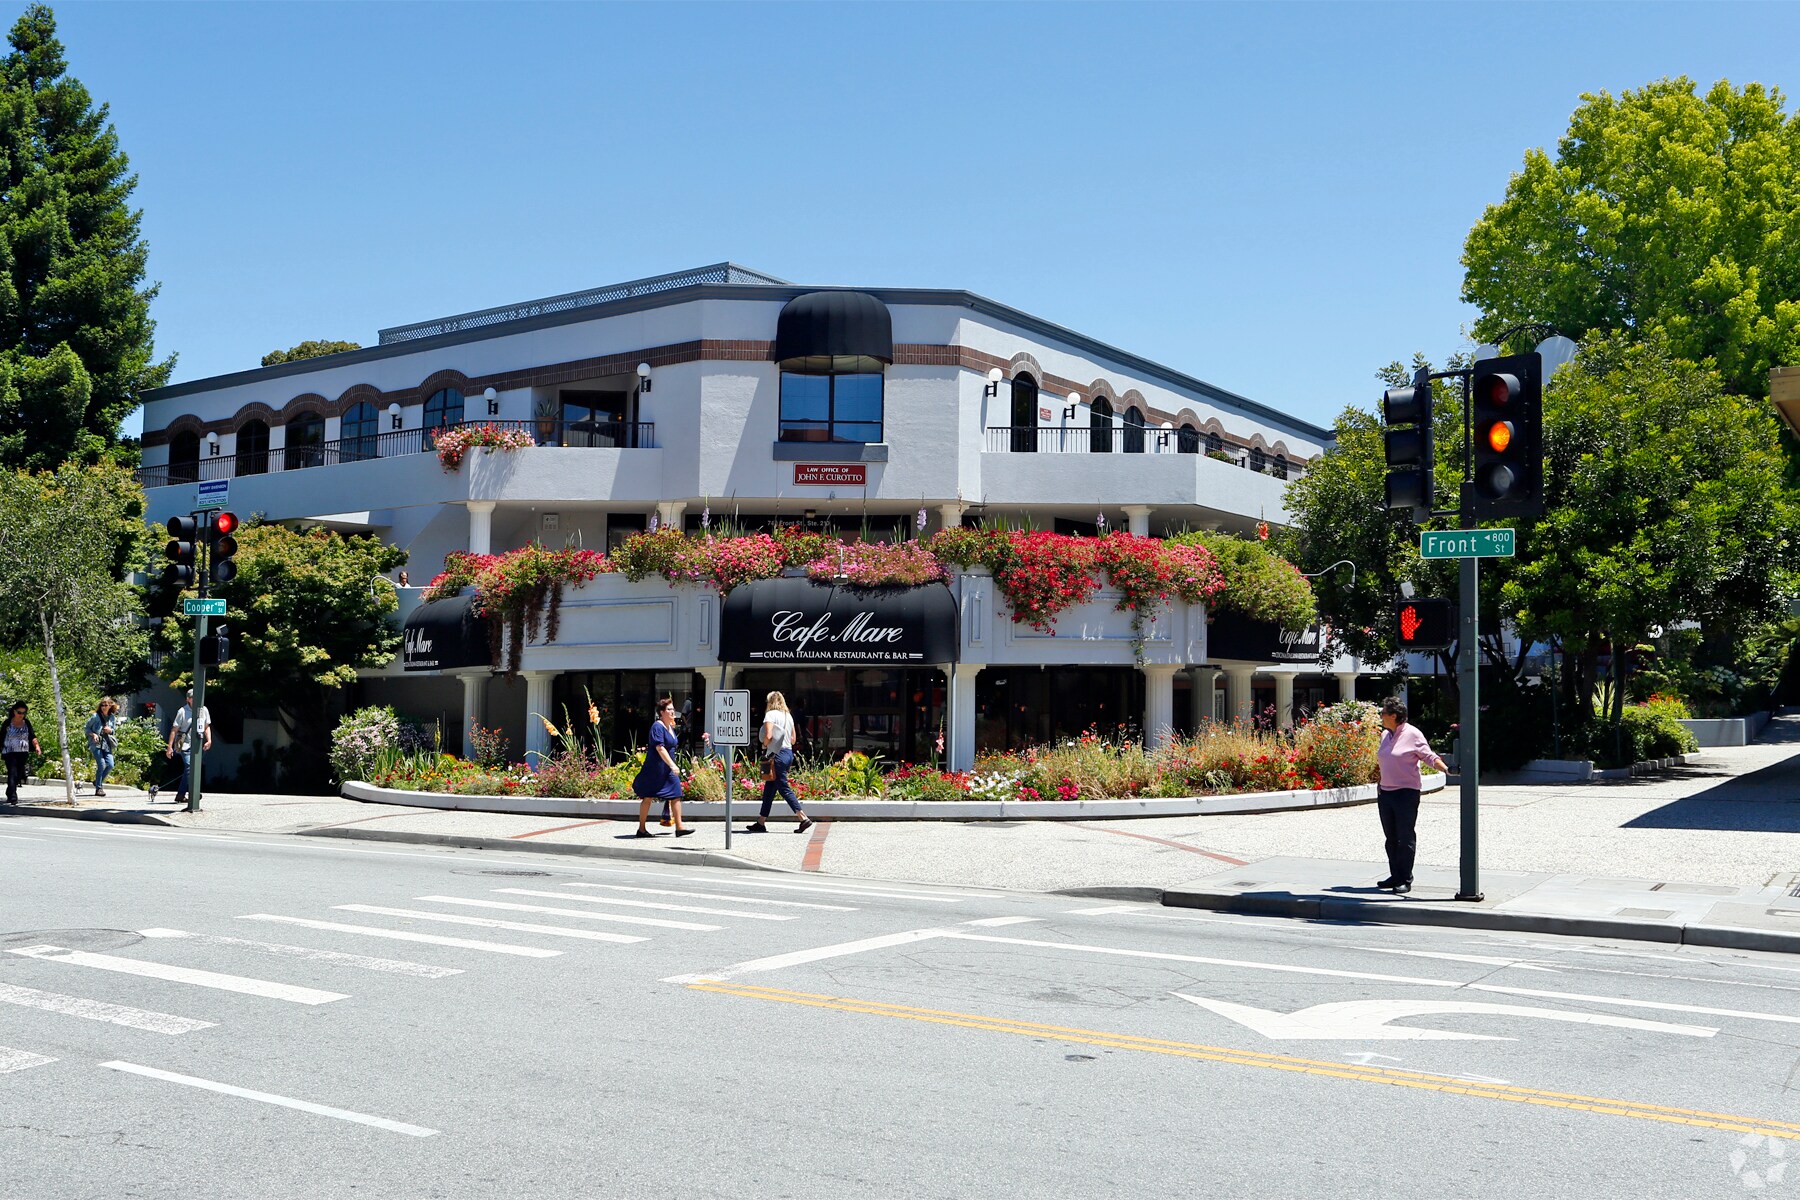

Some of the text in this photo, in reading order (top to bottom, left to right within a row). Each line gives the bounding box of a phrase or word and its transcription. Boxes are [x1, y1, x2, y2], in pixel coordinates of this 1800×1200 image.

[798, 474, 818, 482] JOHN
[1492, 532, 1510, 542] 800
[1428, 536, 1476, 553] Front
[1495, 544, 1504, 553] St
[186, 602, 214, 612] Cooper
[772, 610, 903, 651] Cafe Mare
[723, 696, 734, 706] NO
[718, 712, 742, 721] MOTOR
[716, 726, 744, 737] VEHICLES
